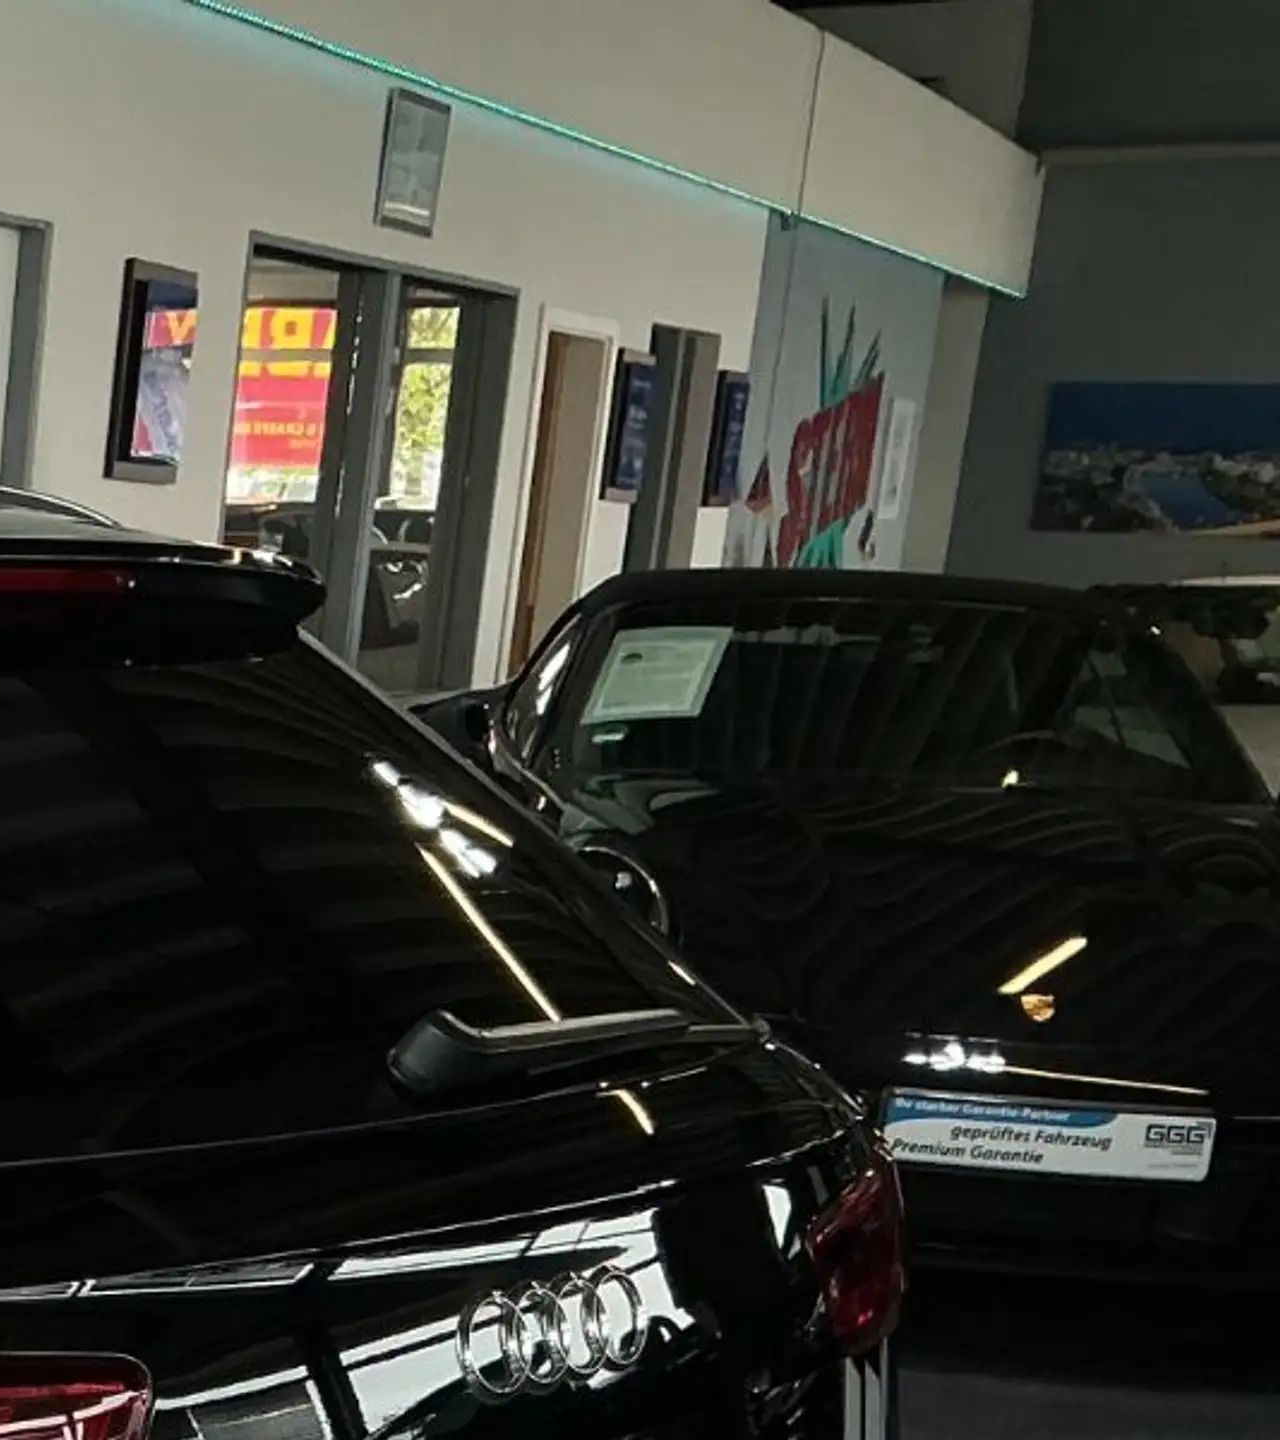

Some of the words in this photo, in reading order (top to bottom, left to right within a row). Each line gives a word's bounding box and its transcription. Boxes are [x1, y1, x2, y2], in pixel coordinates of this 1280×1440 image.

[949, 1125, 1031, 1143] geprüftes
[1033, 1129, 1113, 1151] Fahrzeug
[1145, 1123, 1205, 1144] GGG
[891, 1137, 967, 1157] Premium
[969, 1145, 1044, 1164] Garantie
